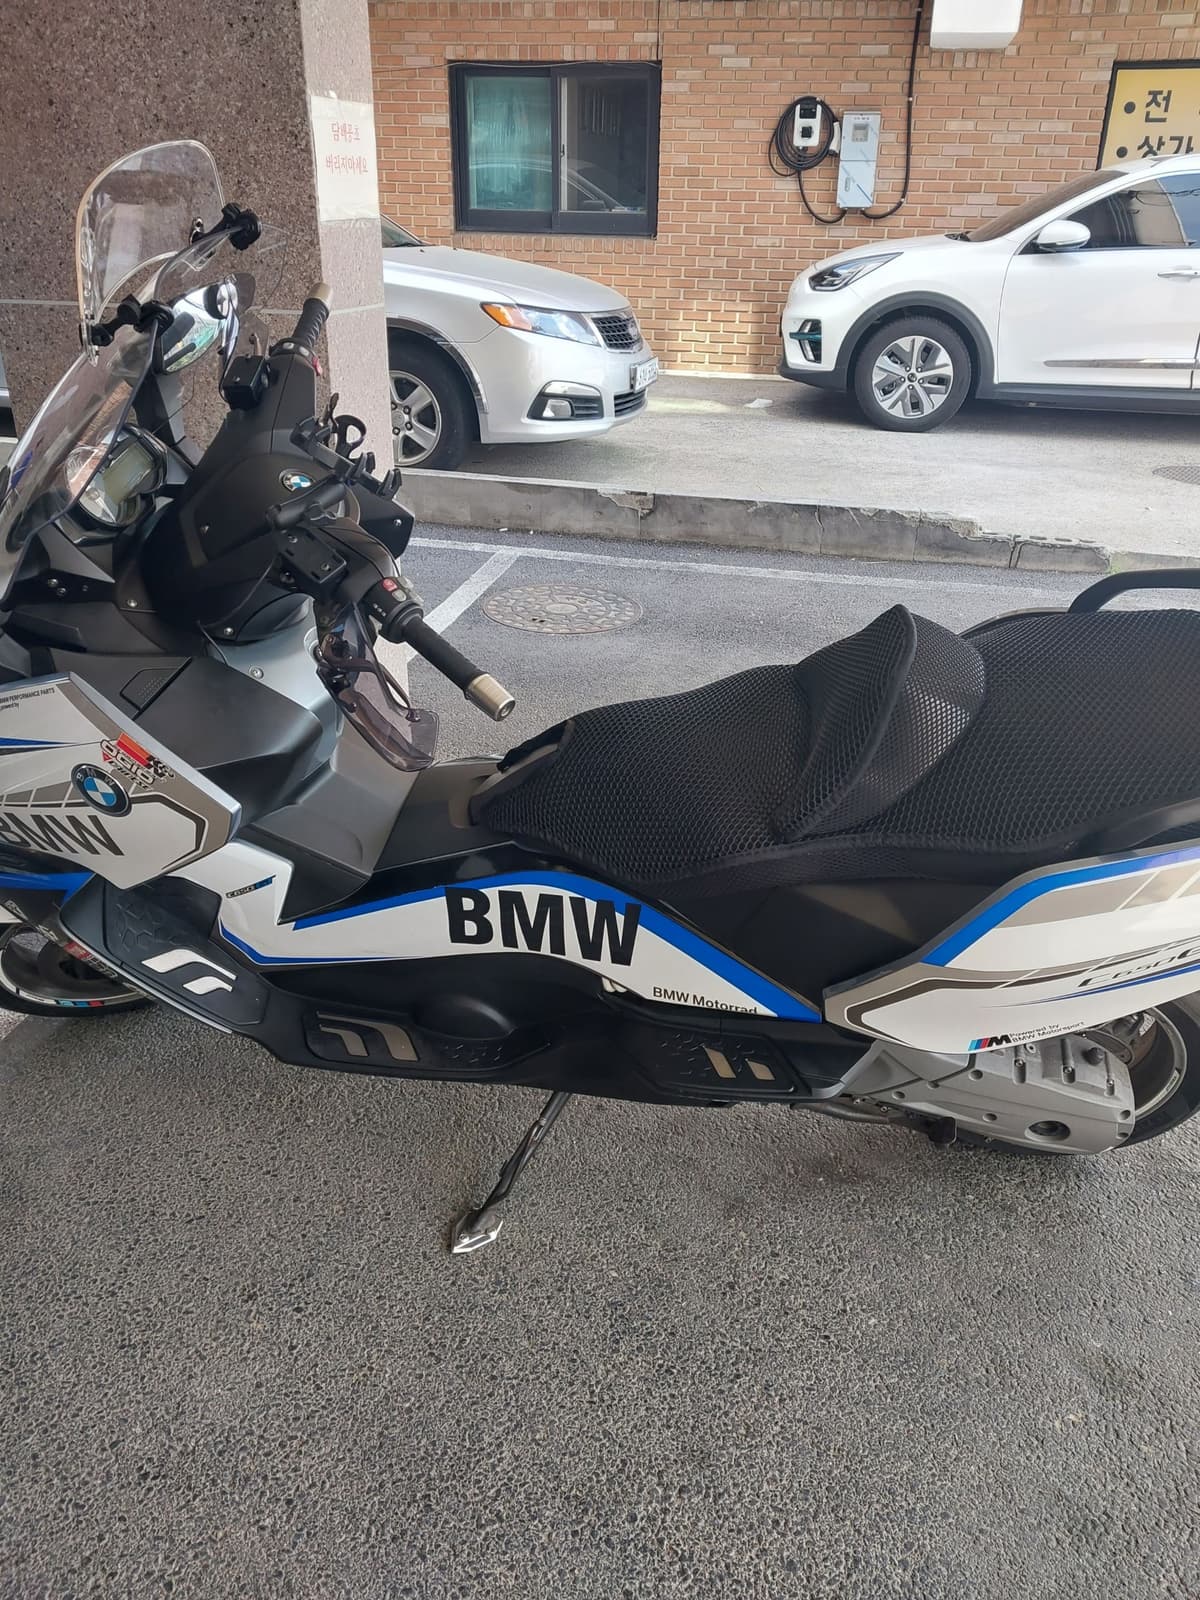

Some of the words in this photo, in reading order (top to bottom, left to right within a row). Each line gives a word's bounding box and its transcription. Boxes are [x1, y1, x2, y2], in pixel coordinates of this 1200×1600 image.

[1144, 90, 1173, 123] 전
[40, 687, 55, 696] PARTS
[101, 739, 155, 785] OGIO
[0, 812, 125, 856] BMW
[445, 886, 642, 966] BMW
[653, 986, 690, 1003] BMW
[692, 994, 758, 1016] Motorrad
[1009, 1026, 1047, 1038] Powered
[1012, 1032, 1036, 1043] BMW
[1037, 1021, 1085, 1038] Motorsport
